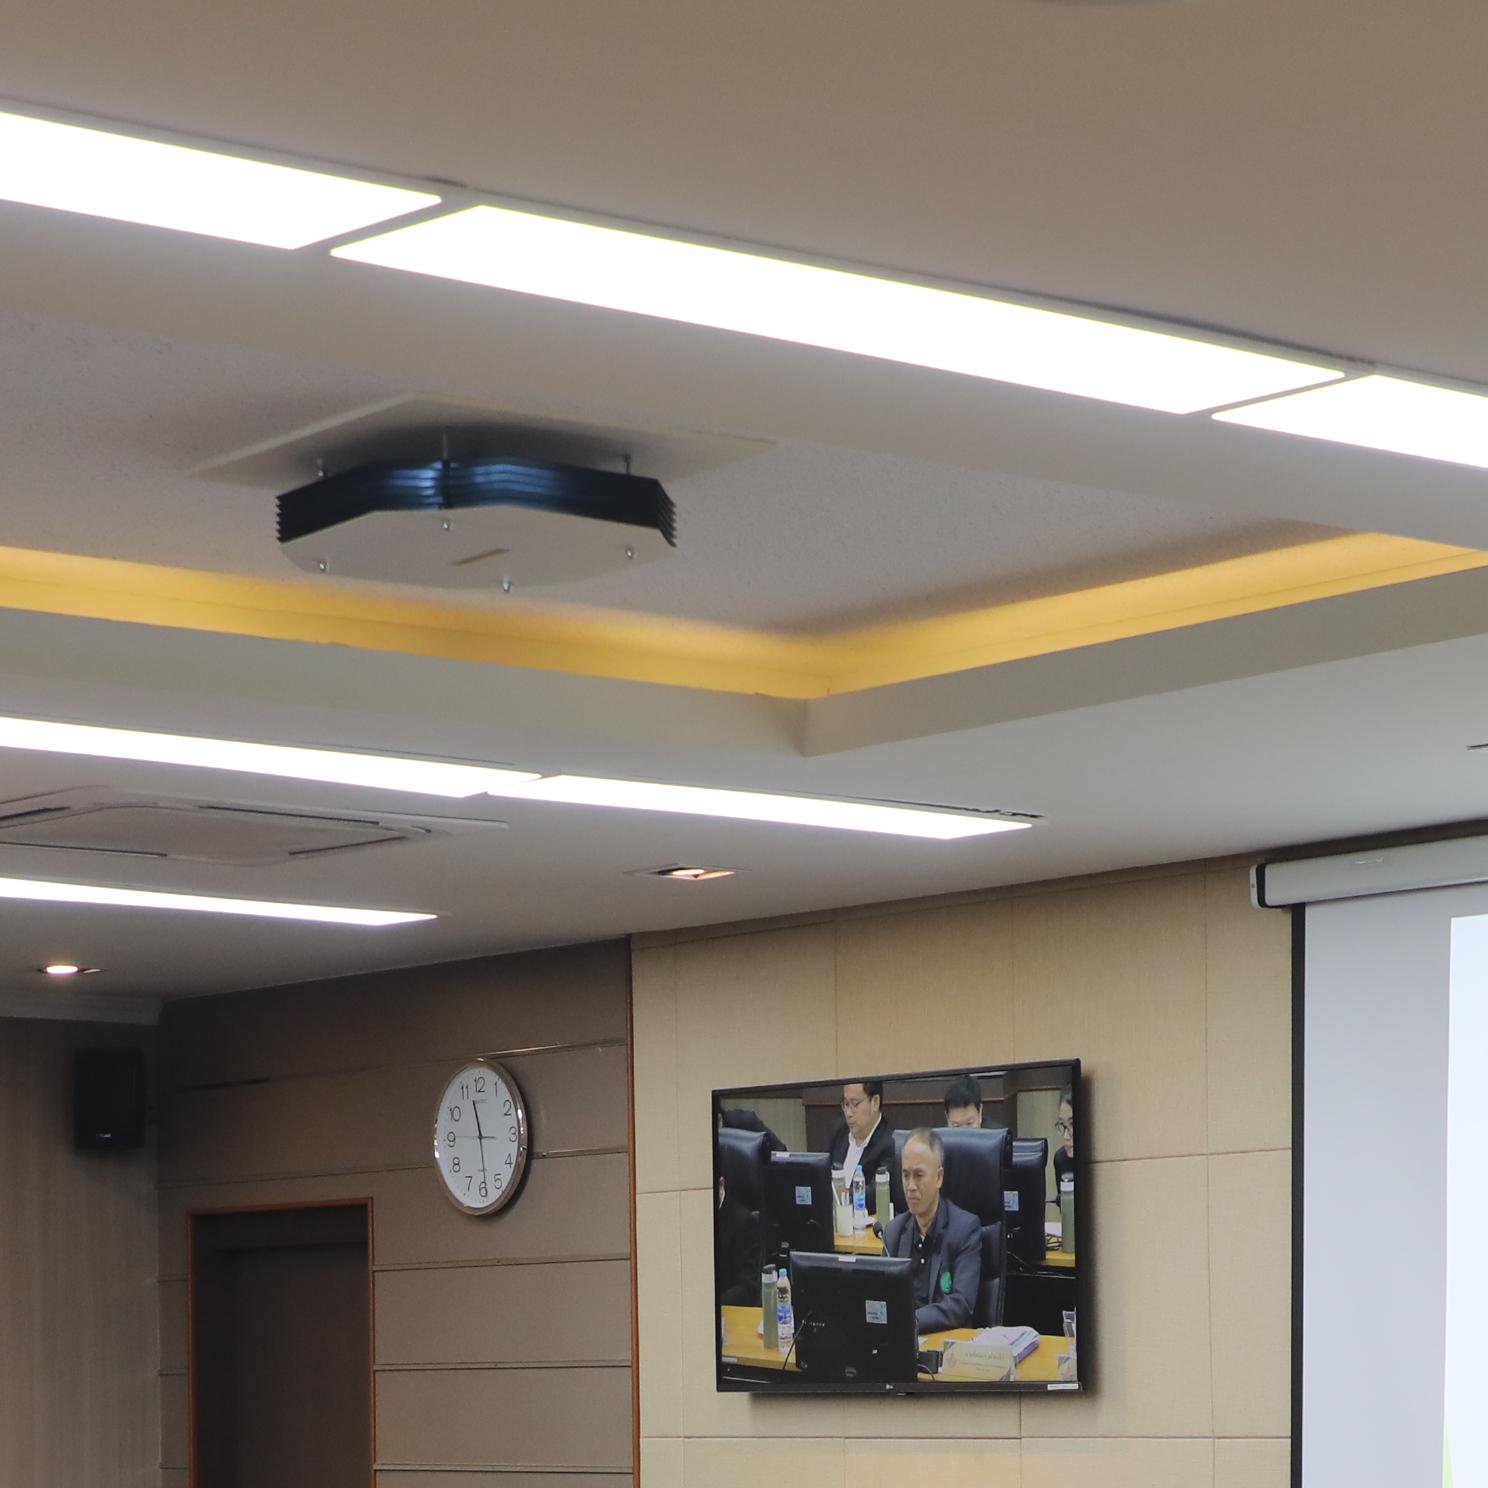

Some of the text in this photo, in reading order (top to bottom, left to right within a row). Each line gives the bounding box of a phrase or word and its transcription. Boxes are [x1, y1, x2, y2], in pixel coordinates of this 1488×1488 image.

[460, 1083, 469, 1100] 11
[474, 1076, 486, 1093] 12
[449, 1105, 462, 1122] 10
[503, 1099, 512, 1117] 2
[446, 1131, 456, 1148] 9
[508, 1126, 518, 1143] 3
[452, 1156, 461, 1173] 8
[504, 1153, 513, 1169] 4
[465, 1175, 473, 1192] 7
[478, 1181, 488, 1198] 6
[493, 1173, 503, 1190] 5
